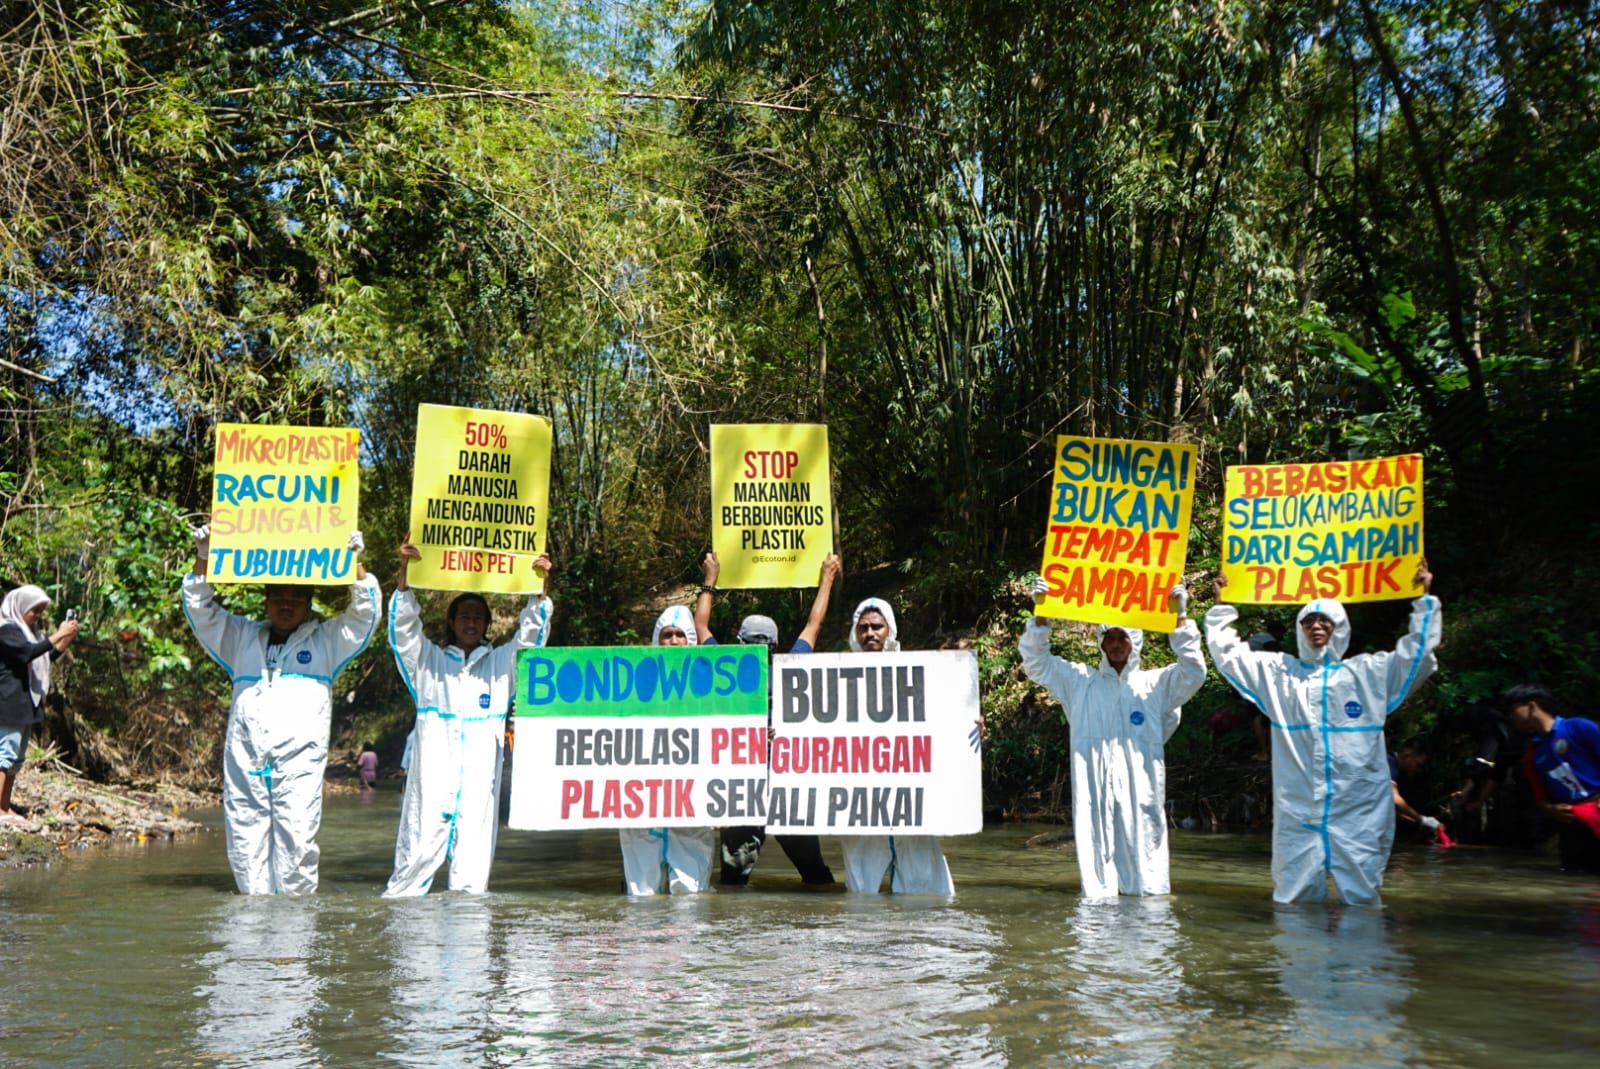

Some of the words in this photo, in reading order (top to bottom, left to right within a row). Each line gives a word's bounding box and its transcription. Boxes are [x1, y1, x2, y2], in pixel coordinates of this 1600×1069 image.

[465, 422, 507, 449] 50%
[458, 450, 511, 474] DARAH
[744, 450, 799, 479] STOP
[1059, 441, 1190, 491] SUNGAI
[1237, 455, 1418, 499] BEBASKAN
[215, 473, 340, 506] RACUNI
[447, 474, 518, 500] MANUSIA
[734, 482, 810, 502] MAKANAN
[211, 506, 322, 536] SUNGAI
[328, 505, 347, 528] &
[427, 498, 536, 526] MENGANDUNG
[722, 506, 824, 526] BERBUNGKUS
[1052, 482, 1180, 532] BUKAN
[1228, 486, 1416, 530] SELOKAMBANG
[422, 524, 537, 551] MIKROPLASTIK
[742, 529, 806, 550] PLASTIK
[1050, 525, 1180, 567] TEMPAT
[1226, 535, 1291, 565] DARI
[1293, 521, 1420, 567] SAMPAH
[210, 547, 353, 579] TUBUHMU
[440, 550, 483, 573] JENIS
[487, 553, 517, 574] PET
[1246, 558, 1403, 602] PLASTIK
[1044, 563, 1176, 613] SAMPAH
[527, 653, 761, 705] BONDOWOSO
[781, 666, 926, 723] BUTUH
[555, 728, 699, 766] REGULASI
[772, 735, 932, 774] GURANGAN
[561, 779, 695, 819] PLASTIK
[828, 787, 924, 826] PAKAI
